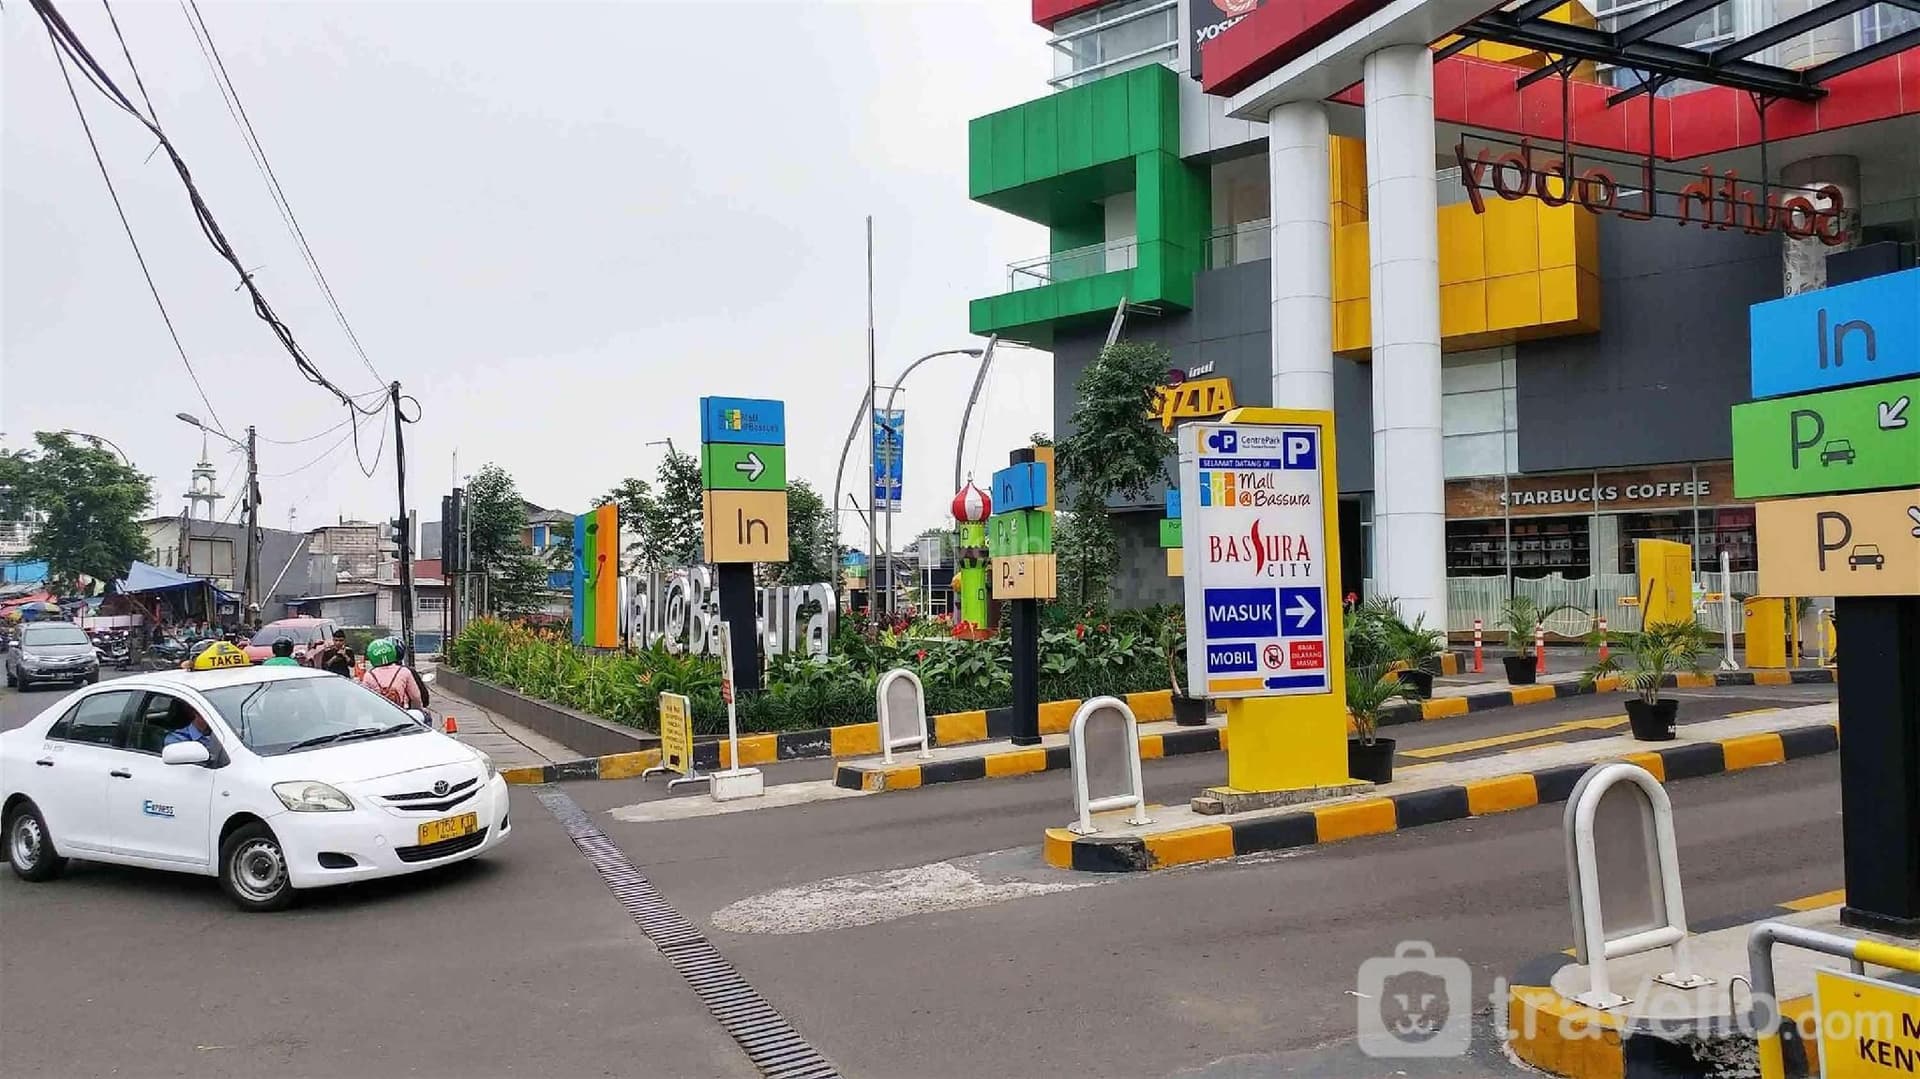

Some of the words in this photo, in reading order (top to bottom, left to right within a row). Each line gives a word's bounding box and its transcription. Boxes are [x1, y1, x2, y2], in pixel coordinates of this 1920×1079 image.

[1817, 308, 1876, 369] In
[1287, 436, 1310, 464] P
[1790, 409, 1824, 470] P
[1003, 480, 1014, 505] In
[1239, 472, 1274, 489] Mall
[1500, 486, 1618, 506] STARBUCKS
[1625, 480, 1712, 500] COFFEE
[1239, 490, 1310, 507] @Bassura
[738, 508, 769, 544] In
[1209, 518, 1311, 577] BASSURA
[1816, 511, 1852, 572] P
[1267, 563, 1311, 577] CITY
[1208, 604, 1272, 622] MASUK
[209, 654, 244, 667] TAKSI
[1210, 651, 1254, 667] MOBIL
[422, 825, 429, 837] B
